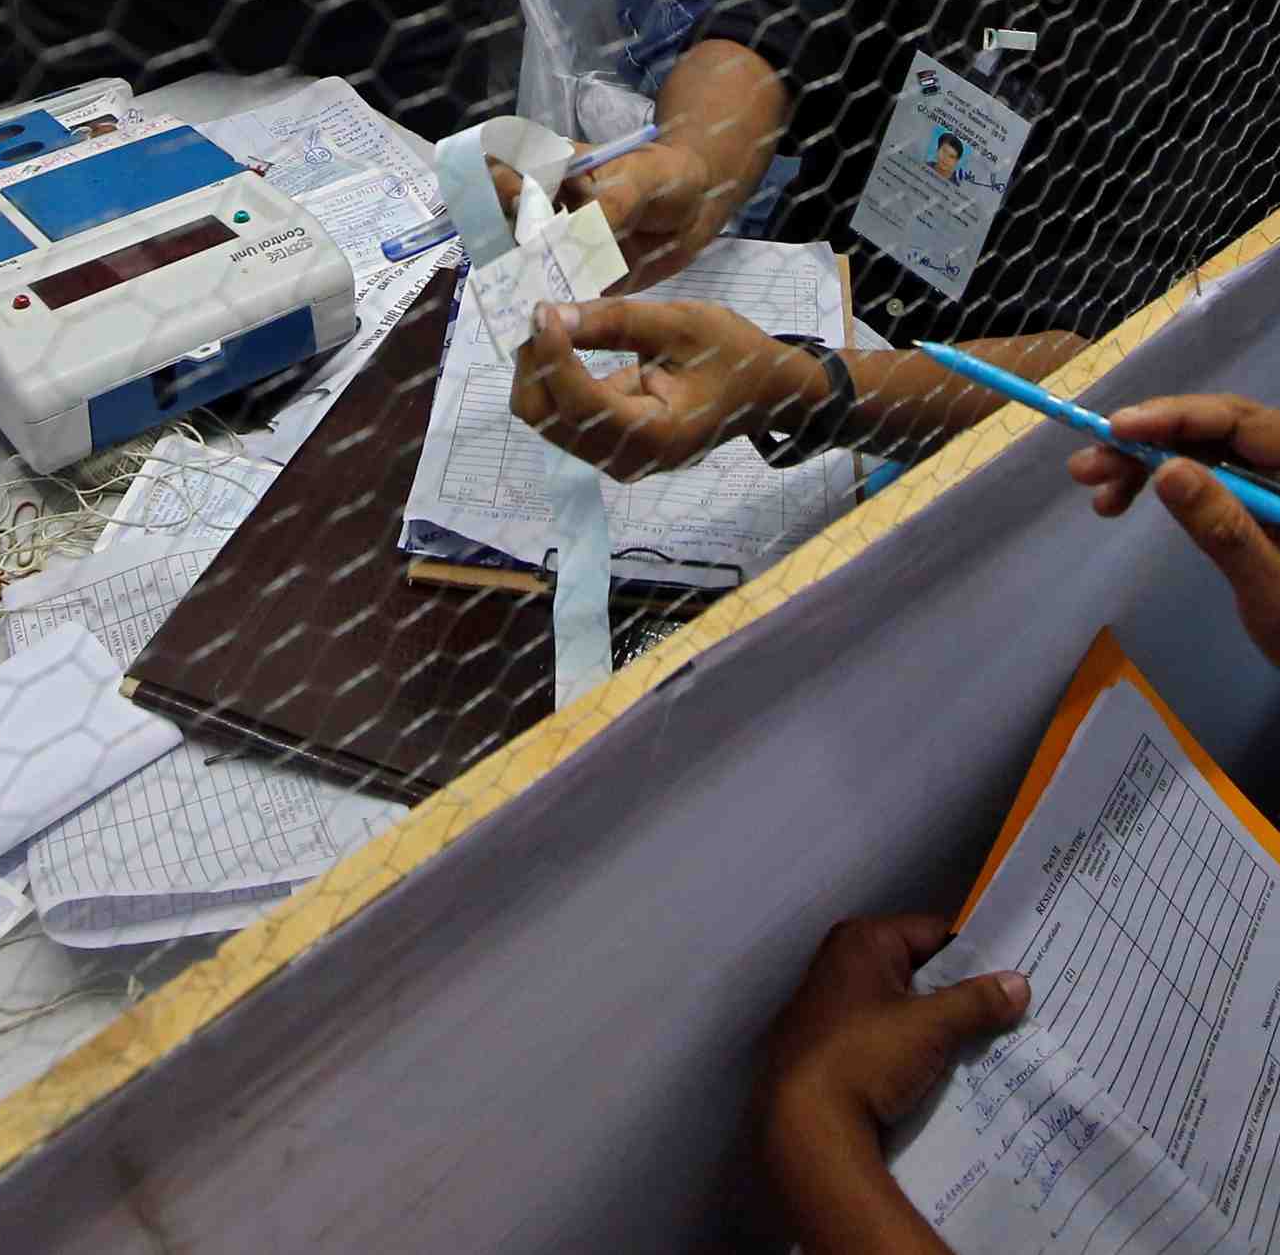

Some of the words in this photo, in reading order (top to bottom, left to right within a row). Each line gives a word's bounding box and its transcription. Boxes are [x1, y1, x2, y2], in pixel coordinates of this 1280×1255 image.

[259, 226, 305, 252] Control
[229, 245, 258, 263] Unit
[1058, 827, 1088, 873] COUNTING
[1052, 869, 1065, 884] OF
[1035, 881, 1058, 916] RESULT
